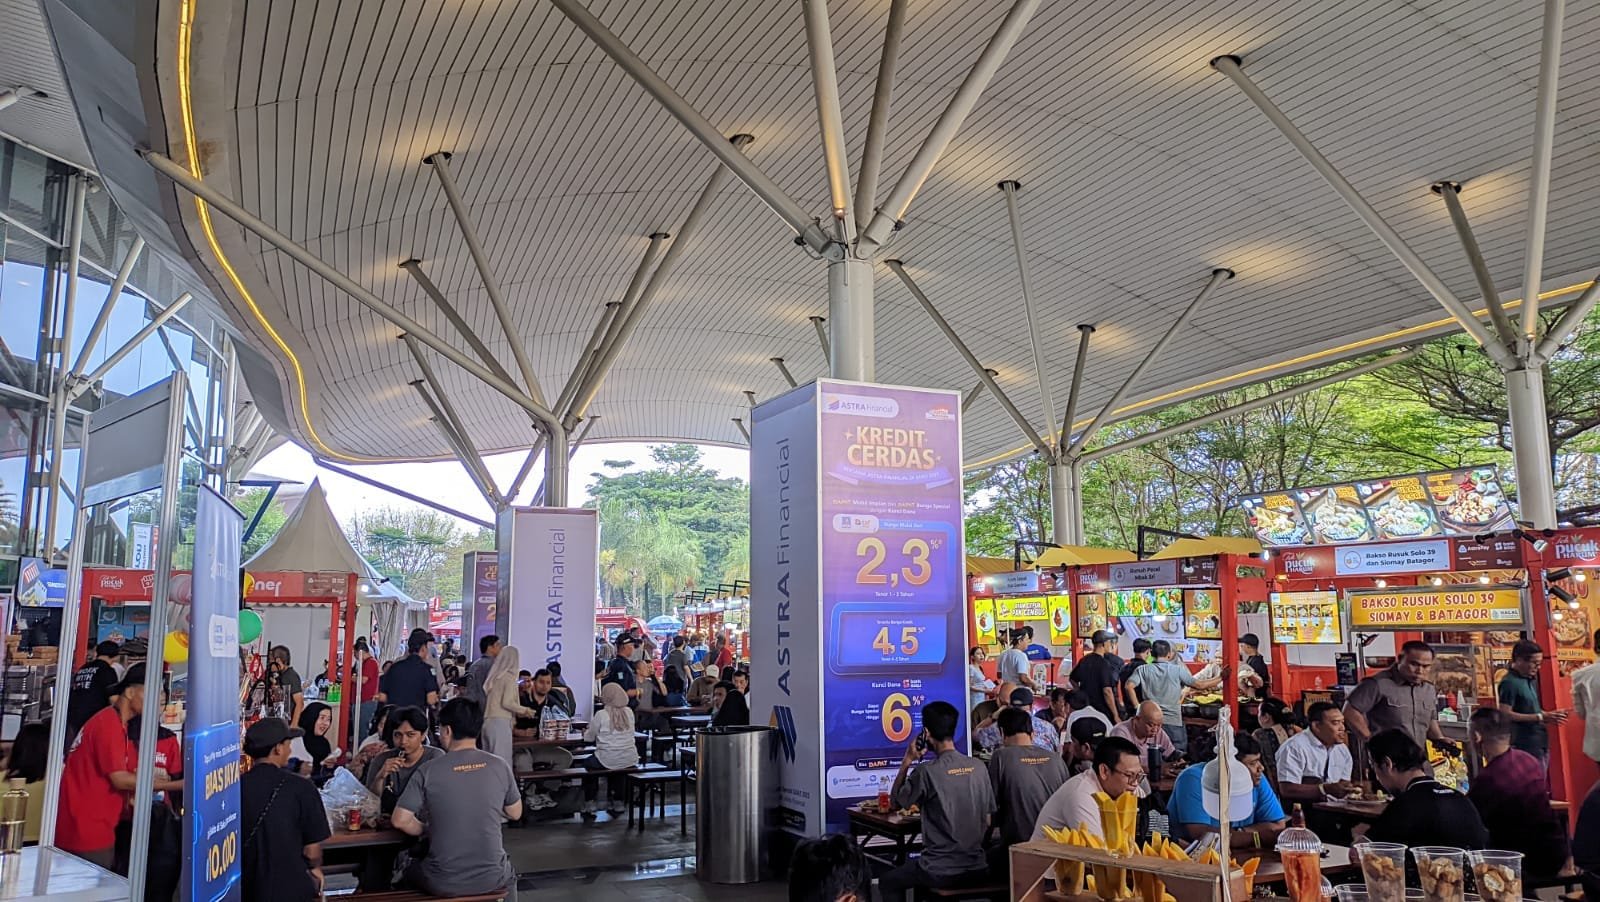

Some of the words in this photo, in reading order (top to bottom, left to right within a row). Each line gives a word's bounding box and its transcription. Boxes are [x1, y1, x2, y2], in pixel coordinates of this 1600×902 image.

[841, 402, 866, 412] ASTRA
[866, 404, 893, 413] Financial
[856, 426, 926, 448] KREDIT
[847, 444, 936, 469] CERDAS
[776, 437, 790, 565] Financial
[856, 536, 932, 587] 2,3
[1555, 540, 1600, 559] pucuk
[548, 528, 566, 598] Financial
[1285, 557, 1316, 570] pucuk
[1381, 559, 1405, 568] Siomay
[1407, 558, 1435, 566] Batagor
[1361, 598, 1396, 609] BAKSO
[1402, 596, 1440, 607] RUSUK
[1445, 594, 1475, 605] SOLO
[1480, 593, 1495, 604] 39
[1369, 612, 1411, 623] SIOMAY
[1416, 611, 1424, 621] &
[1429, 608, 1488, 621] BATAGOR
[546, 601, 563, 665] ASTRA
[777, 572, 791, 696] ASTRA
[872, 626, 919, 655] 4,5
[882, 692, 912, 742] 6
